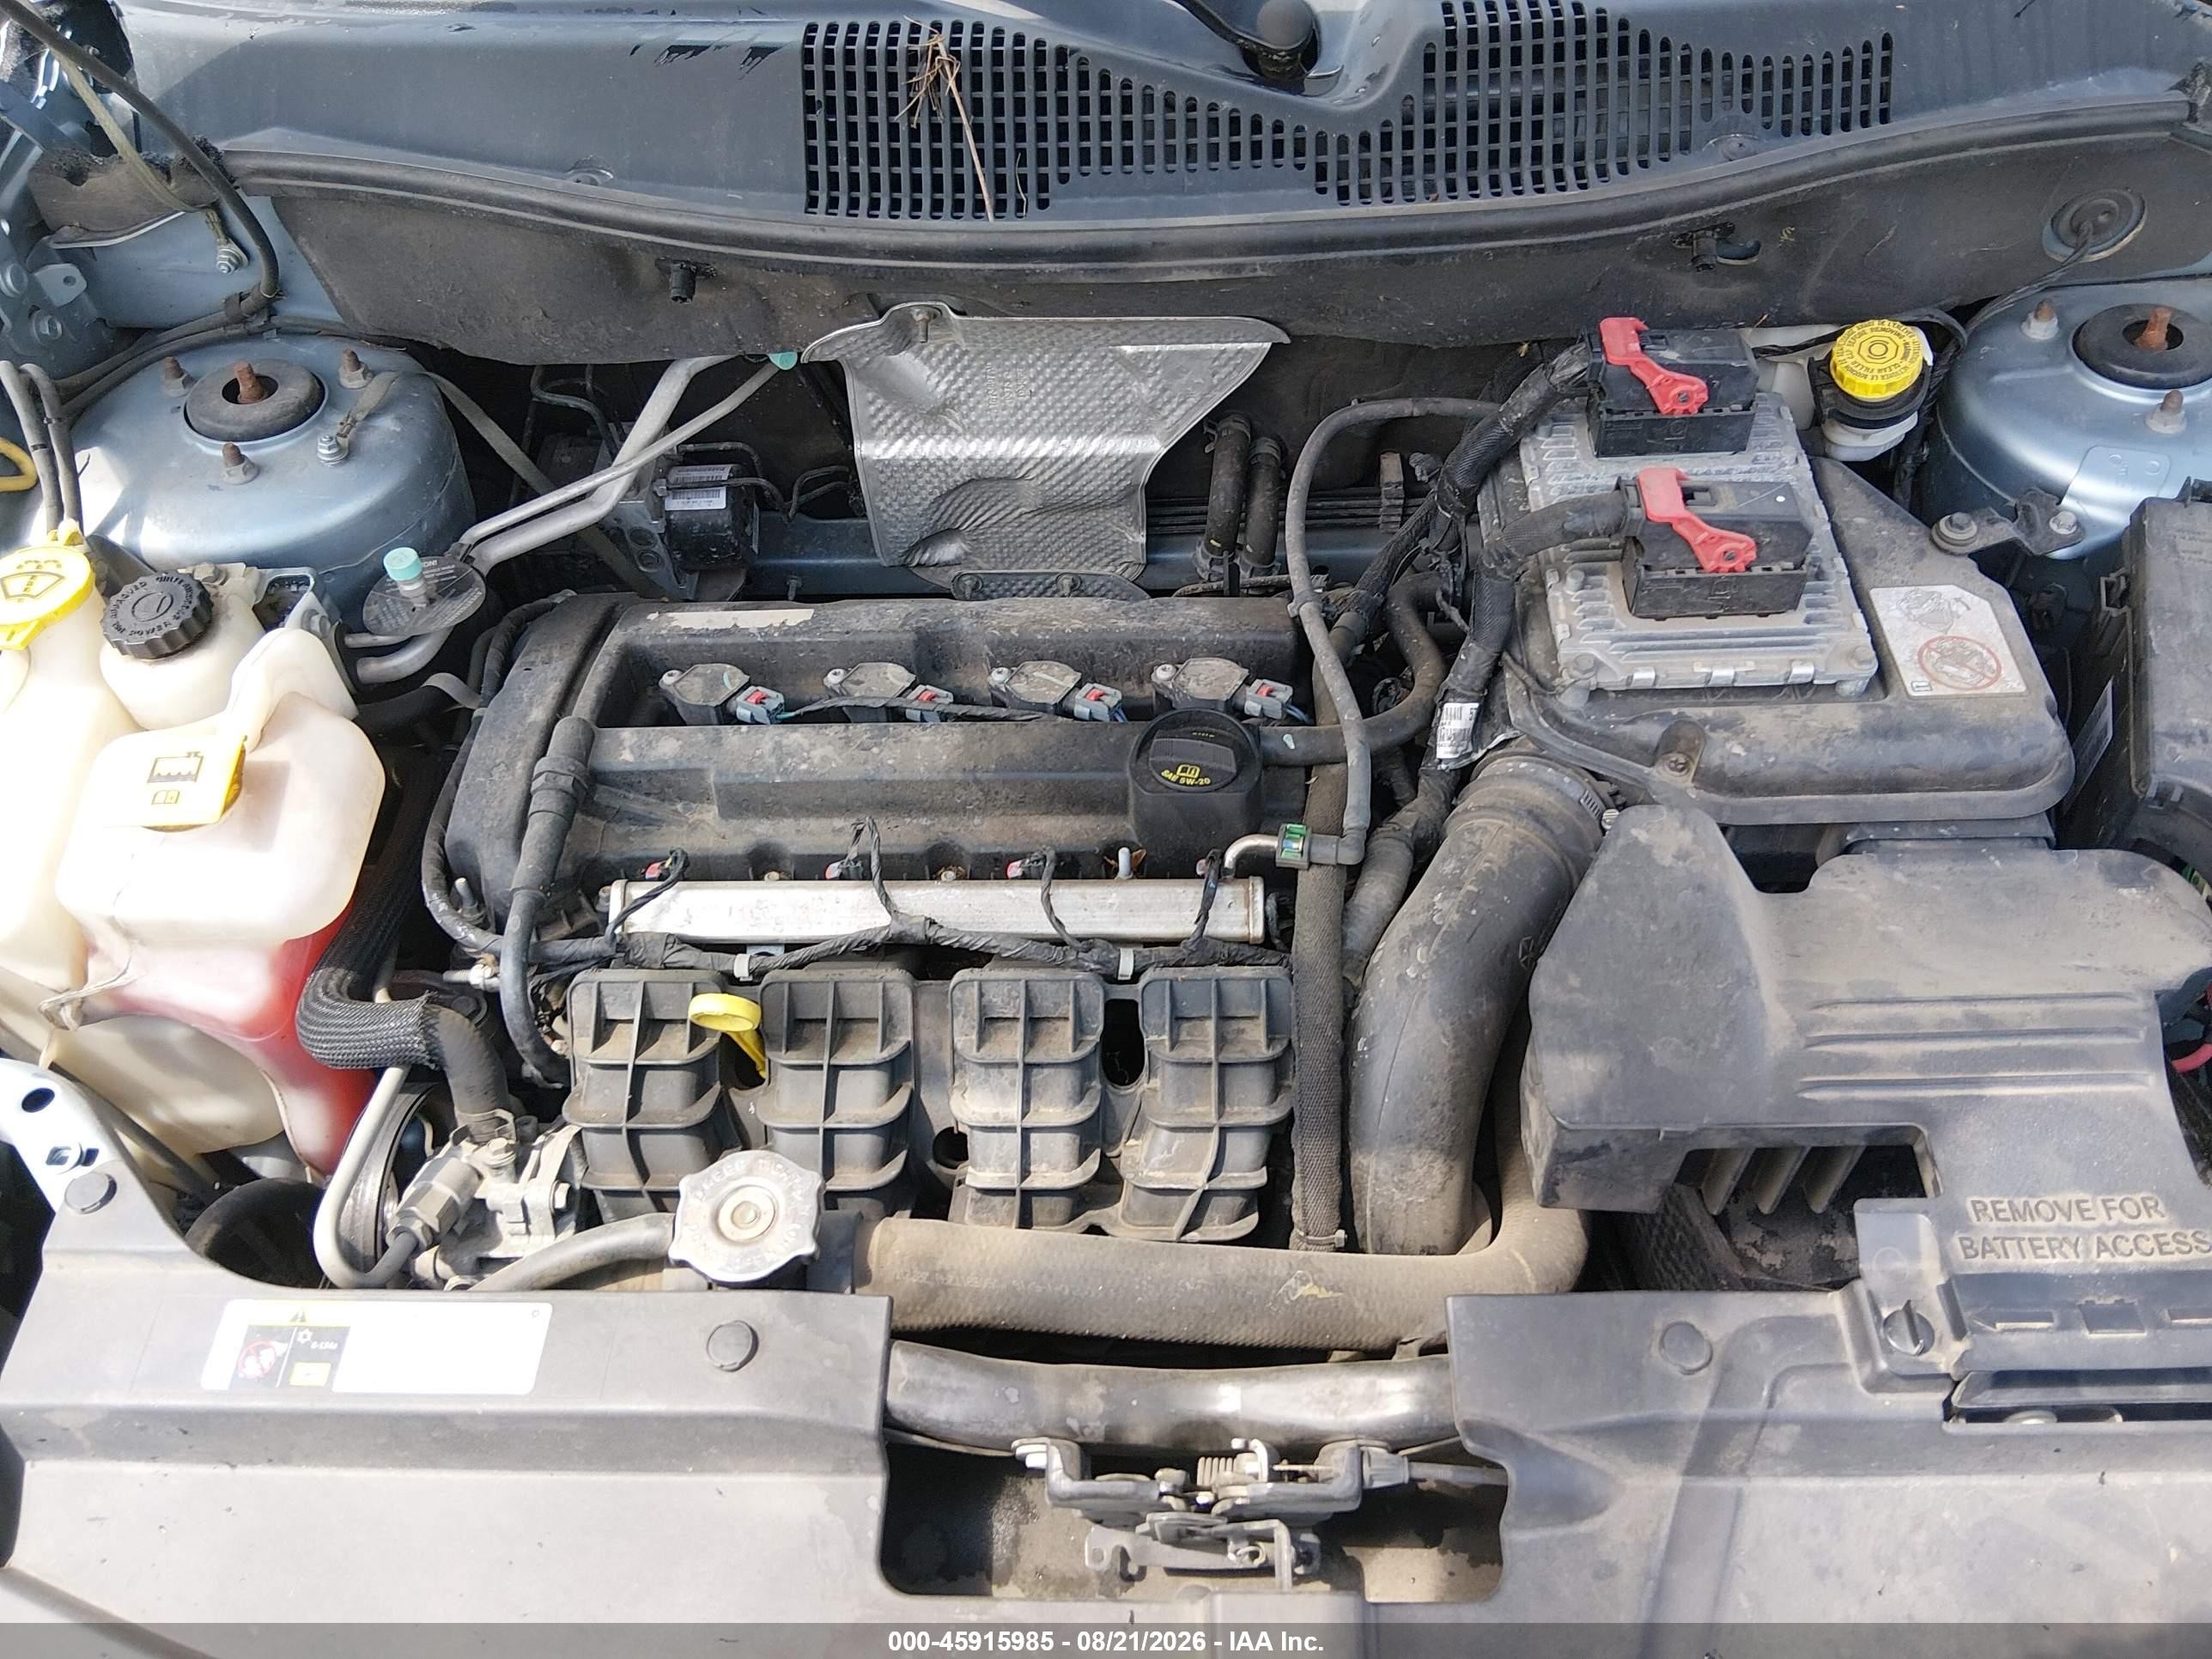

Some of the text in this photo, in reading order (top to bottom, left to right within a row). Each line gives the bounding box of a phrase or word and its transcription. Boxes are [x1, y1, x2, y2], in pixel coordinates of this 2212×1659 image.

[1161, 769, 1211, 785] SAE 5W-20
[1970, 1196, 2165, 1223] REMOVE FOR
[1958, 1230, 2212, 1260] BATTERY ACCESS
